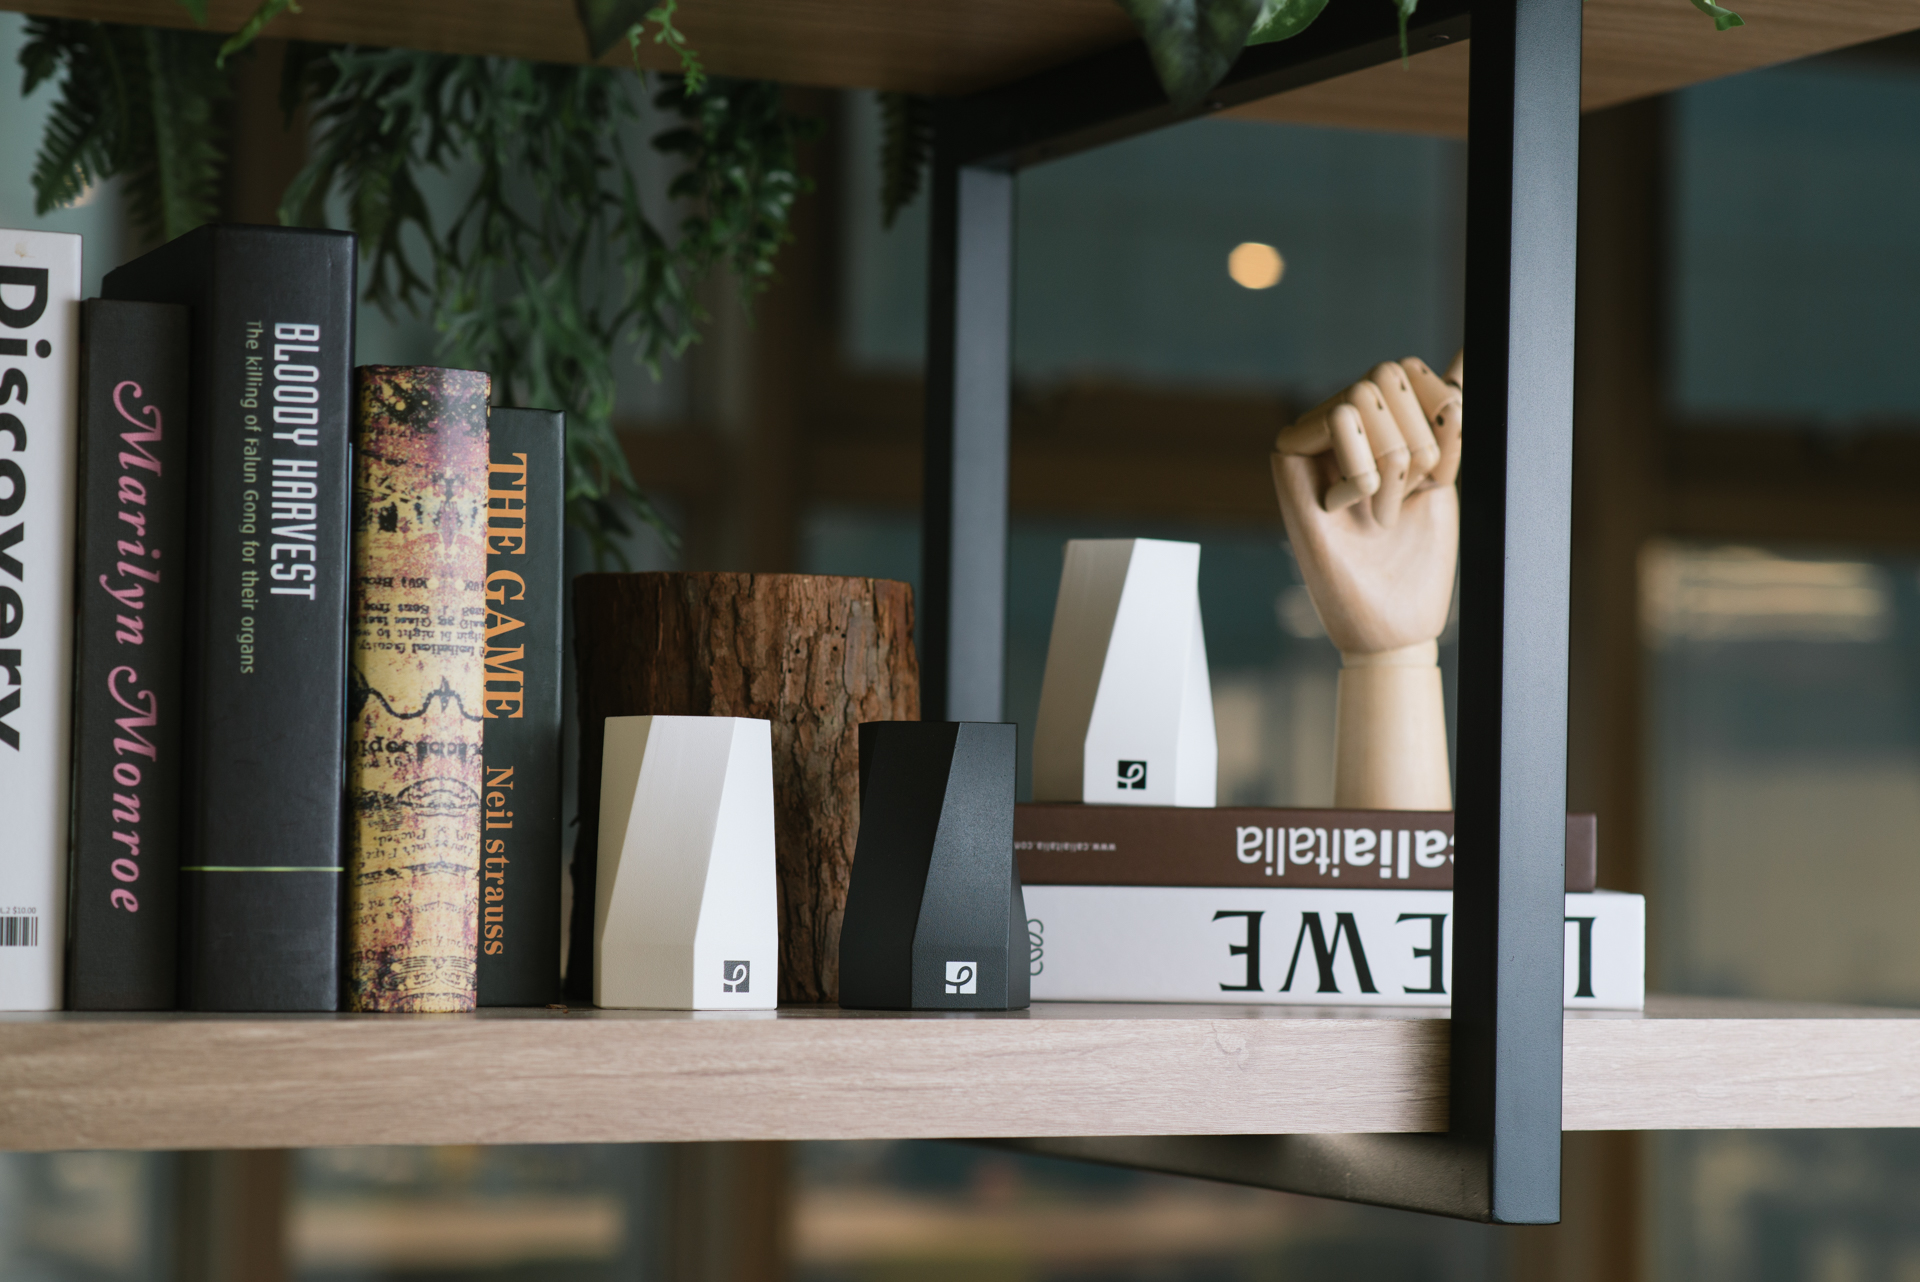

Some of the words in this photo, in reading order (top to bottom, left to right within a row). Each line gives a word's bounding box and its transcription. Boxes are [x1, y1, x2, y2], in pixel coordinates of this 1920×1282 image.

[245, 321, 264, 350] The
[240, 356, 263, 408] killing
[272, 323, 320, 446] BLOODY
[244, 414, 262, 433] of
[243, 438, 262, 483] Falun
[99, 380, 162, 645] Marilyn
[239, 489, 259, 534] Gong
[270, 459, 318, 600] HARVEST
[486, 452, 527, 555] THE
[242, 540, 260, 564] for
[241, 570, 260, 611] their
[237, 616, 256, 674] organs
[484, 569, 526, 719] GAME
[107, 665, 158, 913] Monroe
[485, 765, 514, 831] Neil
[1236, 826, 1455, 879] aliaitalia
[12, 905, 37, 915] $10.00
[483, 839, 511, 956] strauss
[1211, 910, 1598, 998] LEWE
